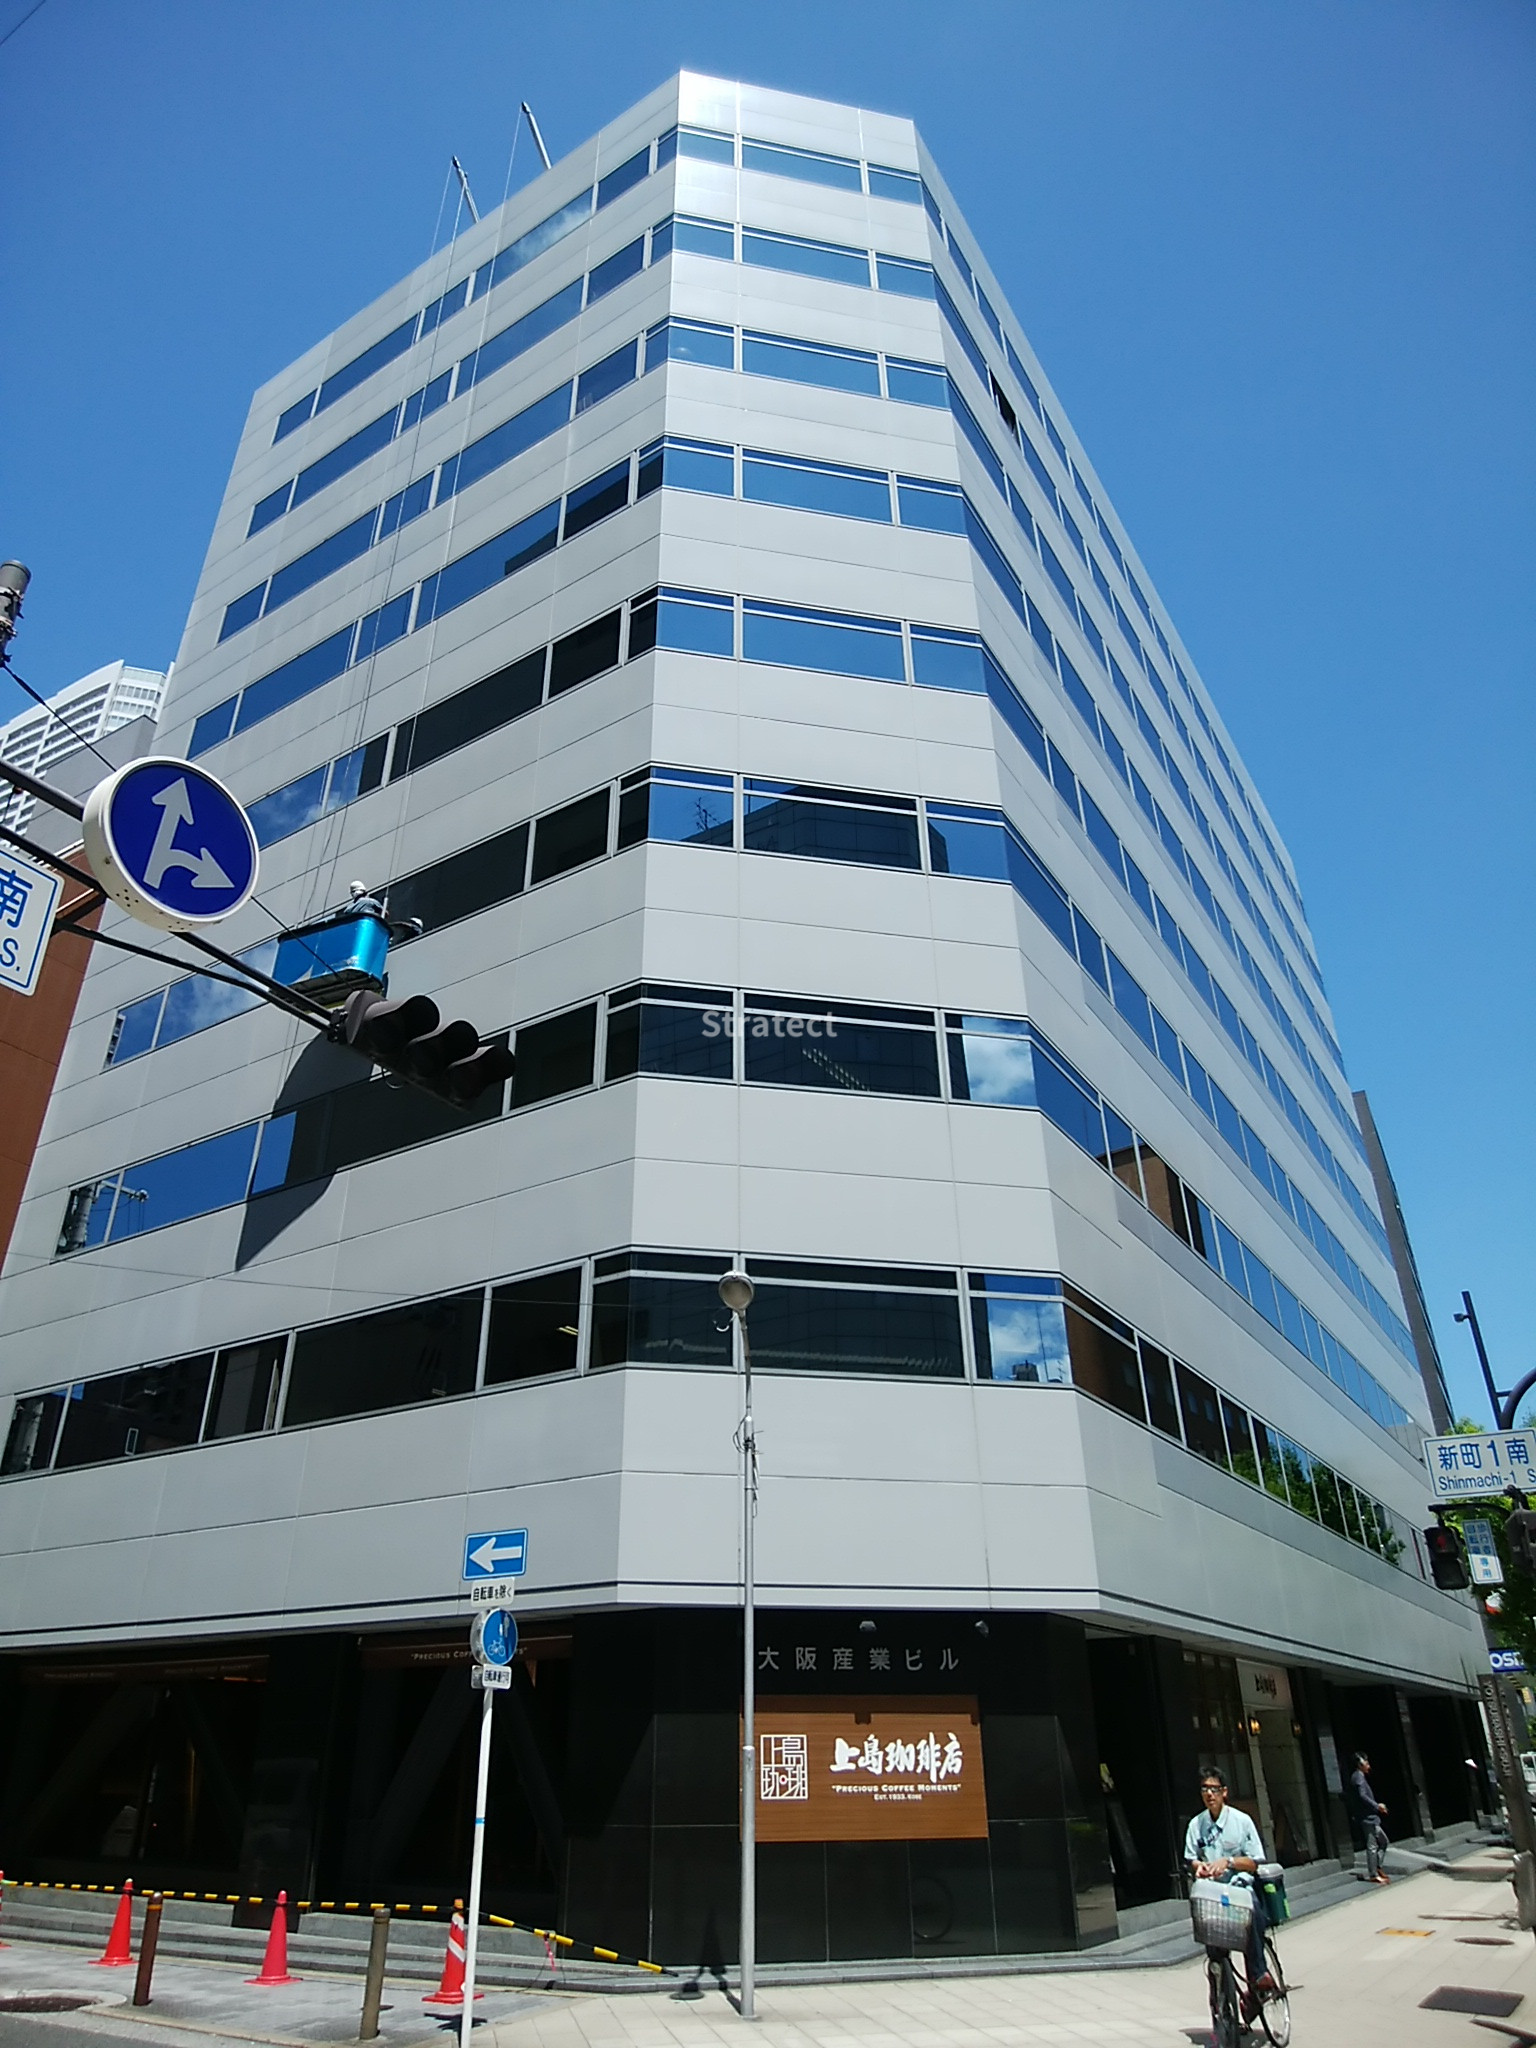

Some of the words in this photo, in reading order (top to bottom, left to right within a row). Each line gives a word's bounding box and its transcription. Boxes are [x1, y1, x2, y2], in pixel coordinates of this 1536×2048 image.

[0, 869, 33, 928] 南
[1437, 1438, 1529, 1470] 新町1南
[1438, 1470, 1517, 1491] Shinmachi-1
[758, 1647, 959, 1671] 大阪産業ビル
[829, 1732, 963, 1783] 上島珈琲店
[881, 1784, 915, 1792] COFFEE
